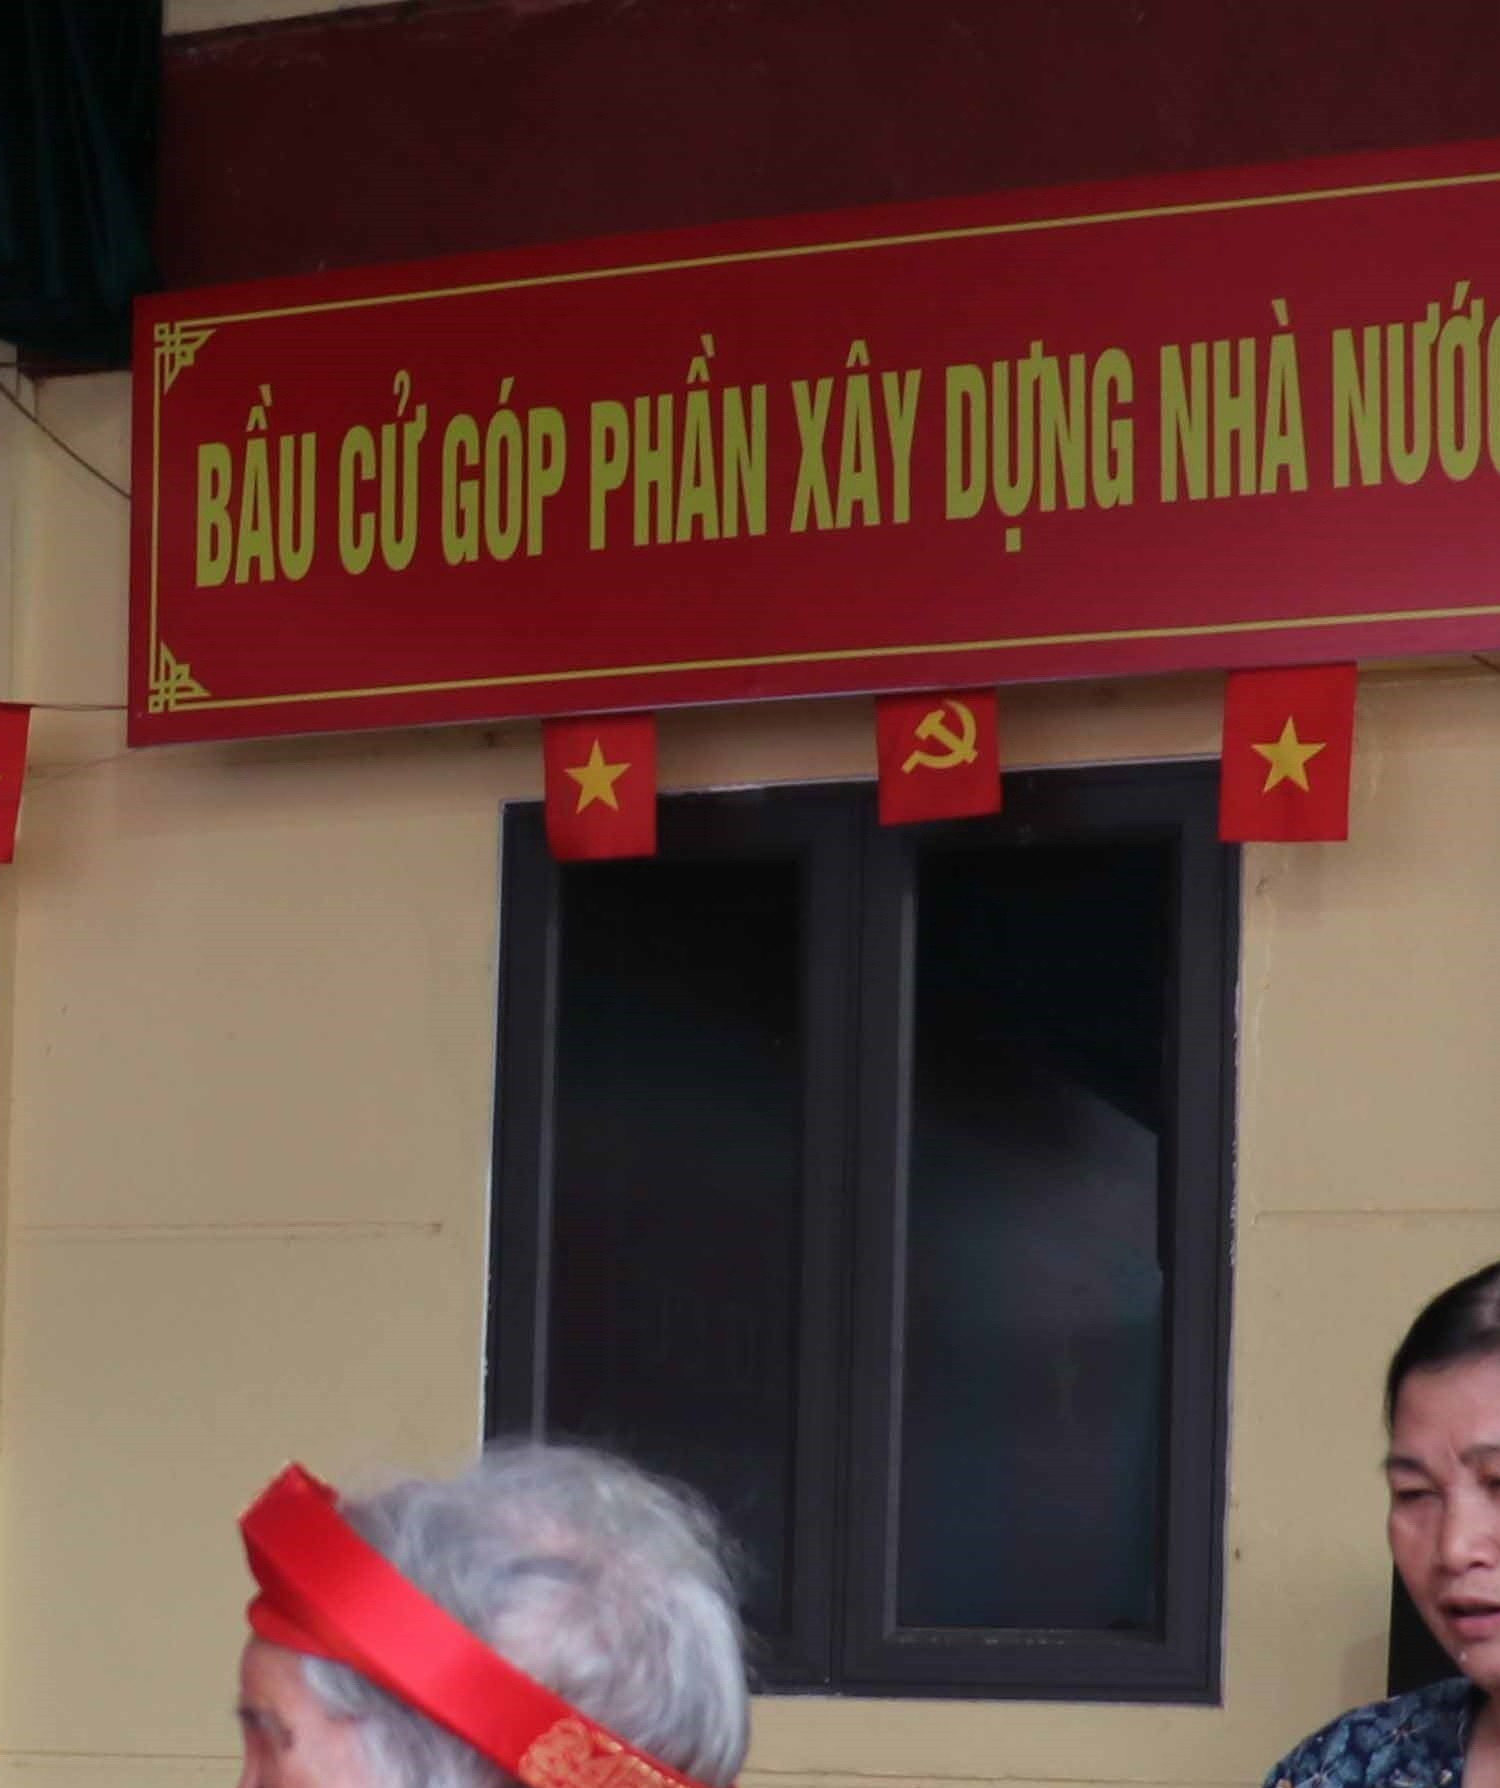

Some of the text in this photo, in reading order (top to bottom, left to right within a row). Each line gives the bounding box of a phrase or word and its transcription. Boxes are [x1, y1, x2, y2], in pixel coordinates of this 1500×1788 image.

[196, 385, 316, 587] BẦU
[340, 373, 426, 572] CỬ
[444, 379, 565, 563] GÓP
[591, 336, 766, 548] PHẦN
[794, 342, 920, 530] XÂY
[947, 343, 1133, 550] DỰNG
[1162, 300, 1307, 501] NHÀ
